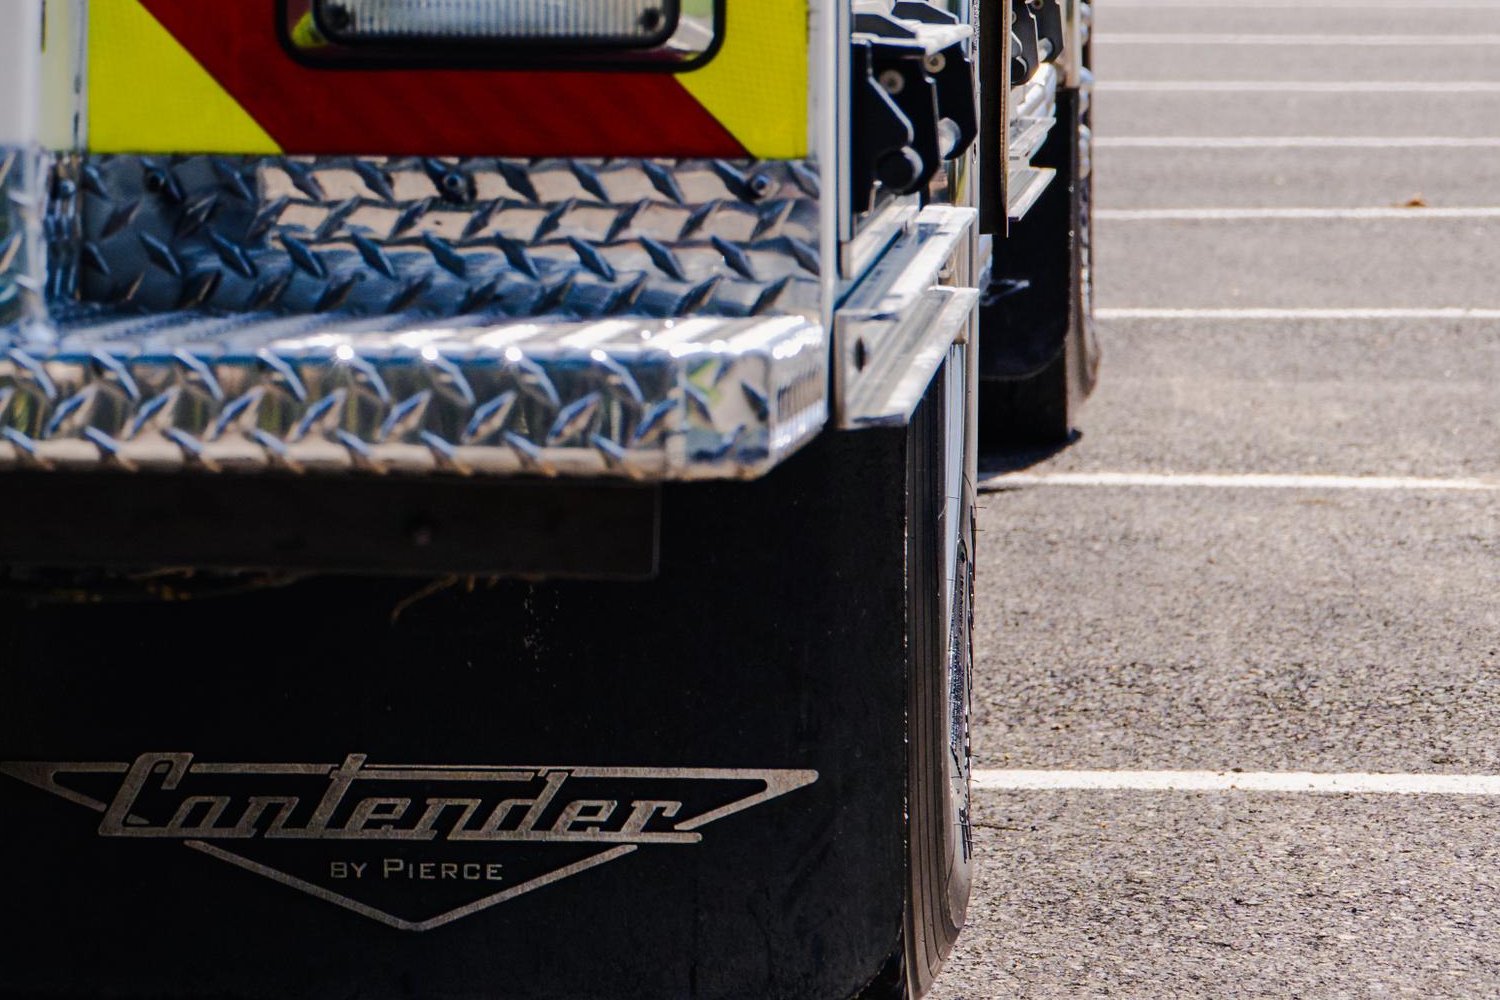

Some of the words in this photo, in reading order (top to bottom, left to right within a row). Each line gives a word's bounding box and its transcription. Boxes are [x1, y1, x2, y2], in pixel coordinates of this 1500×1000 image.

[99, 752, 701, 843] Contender
[330, 862, 367, 879] BY
[383, 859, 503, 881] PIERCE
